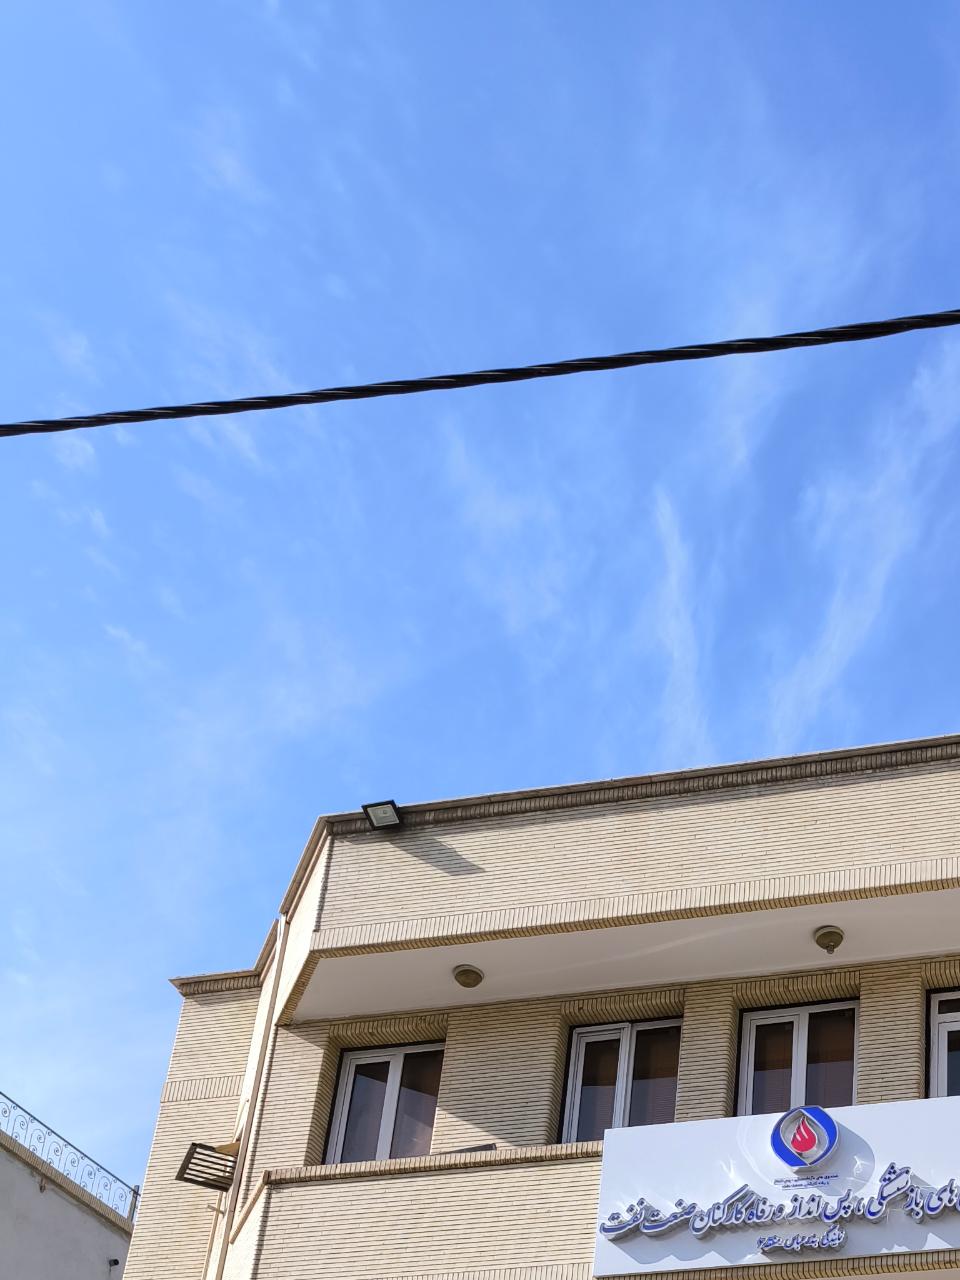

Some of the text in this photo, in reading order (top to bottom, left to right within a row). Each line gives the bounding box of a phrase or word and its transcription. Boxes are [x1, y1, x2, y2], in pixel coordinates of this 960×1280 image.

[787, 1193, 821, 1222] انداز
[823, 1189, 853, 1222] پس
[865, 1162, 924, 1219] بازنشستگی
[925, 1179, 958, 1215] های
[600, 1197, 645, 1234] نفت
[639, 1198, 698, 1233] صنعت
[689, 1184, 753, 1236] کارکنان
[744, 1196, 774, 1223] رفاه
[775, 1203, 787, 1221] و
